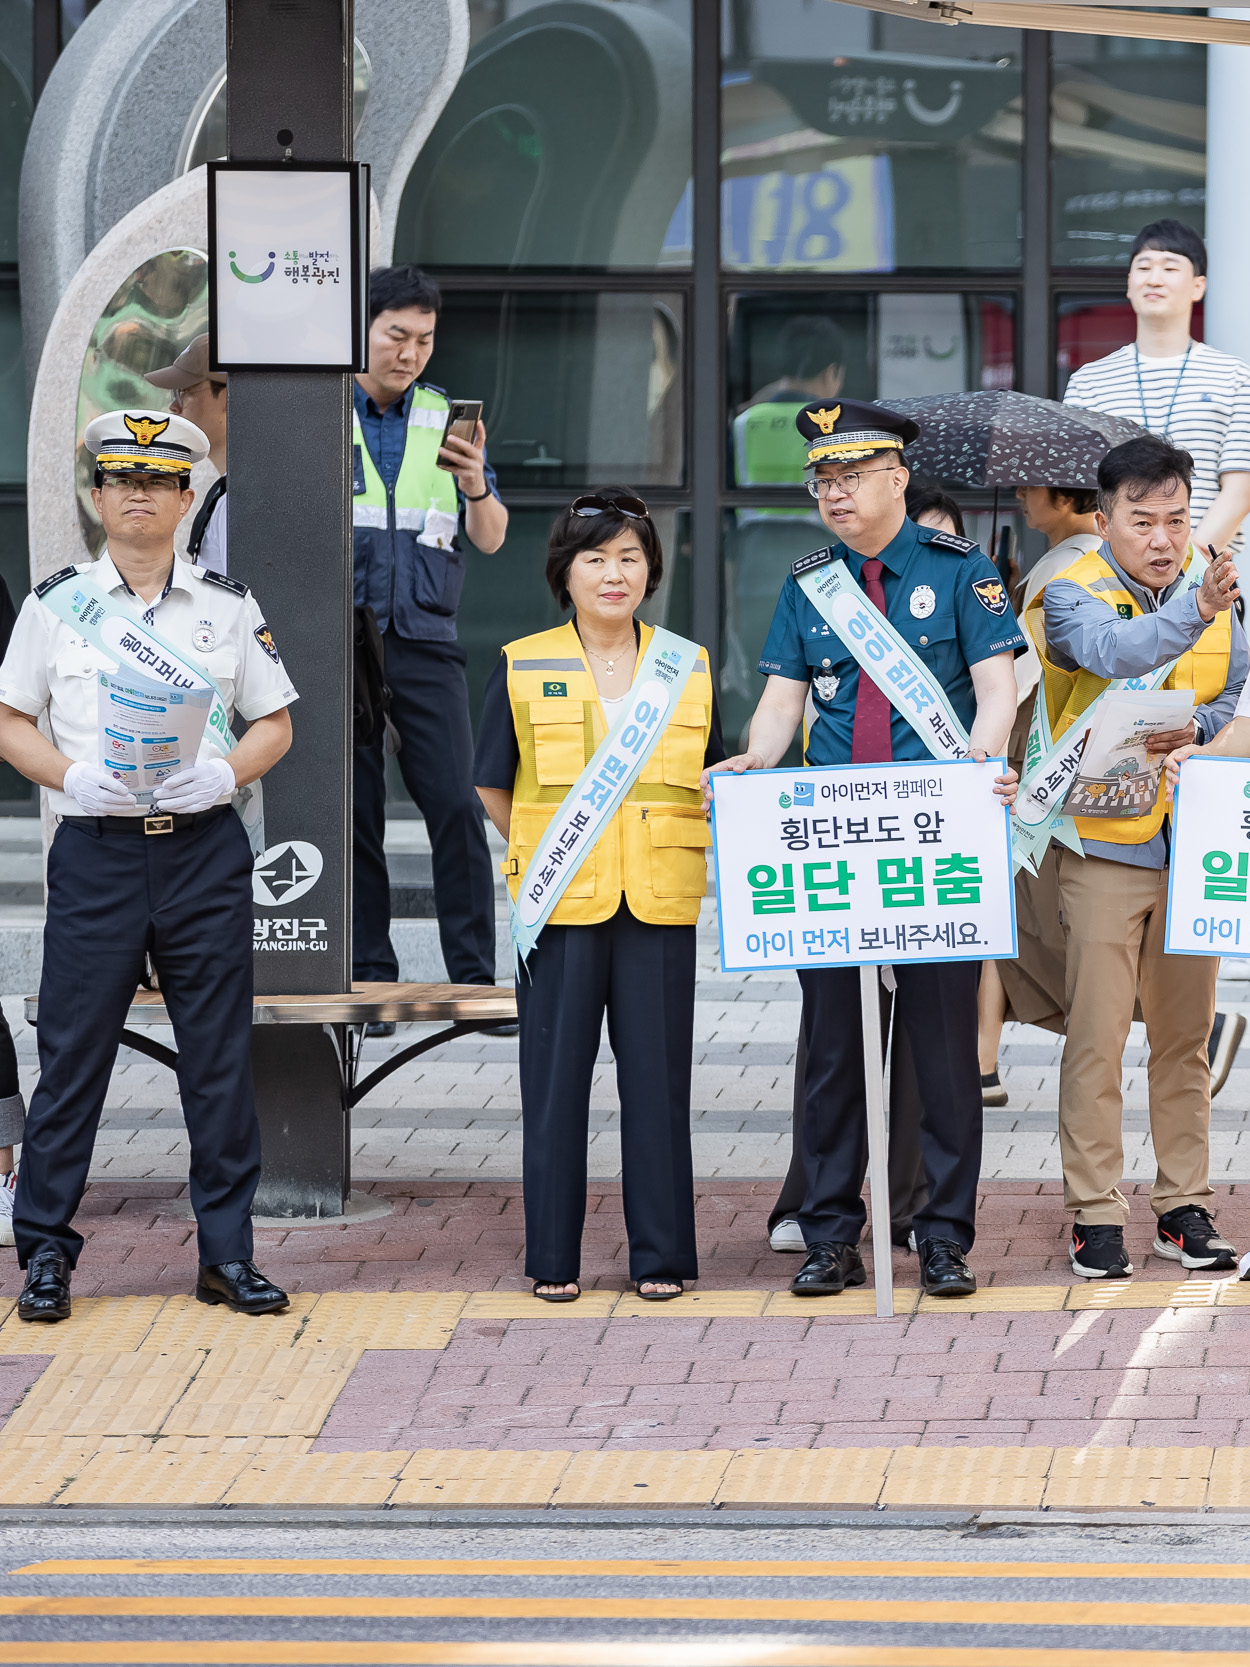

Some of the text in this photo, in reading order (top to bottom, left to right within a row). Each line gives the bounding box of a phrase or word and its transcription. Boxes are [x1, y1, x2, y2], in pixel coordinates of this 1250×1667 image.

[284, 265, 339, 285] 행복광진
[817, 572, 840, 595] 아이먼저
[825, 581, 842, 599] 캠페인
[79, 597, 99, 623] 아이먼저
[90, 607, 106, 626] 캠페인
[990, 602, 1004, 610] POLICE
[654, 659, 680, 678] 아이먼저
[848, 610, 894, 662] 아이
[885, 659, 936, 715] 먼저
[655, 669, 674, 684] 캠페인
[821, 777, 943, 803] 아이먼저 캠페인
[528, 701, 660, 904] 아이 먼저 보내주세요
[780, 811, 944, 851] 횡단보도 앞
[747, 853, 983, 915] 일단 멈춤
[746, 922, 989, 958] 아이 먼저 보내주세요.
[1193, 917, 1240, 945] 아이
[253, 941, 328, 951] WANGJIN-GU
